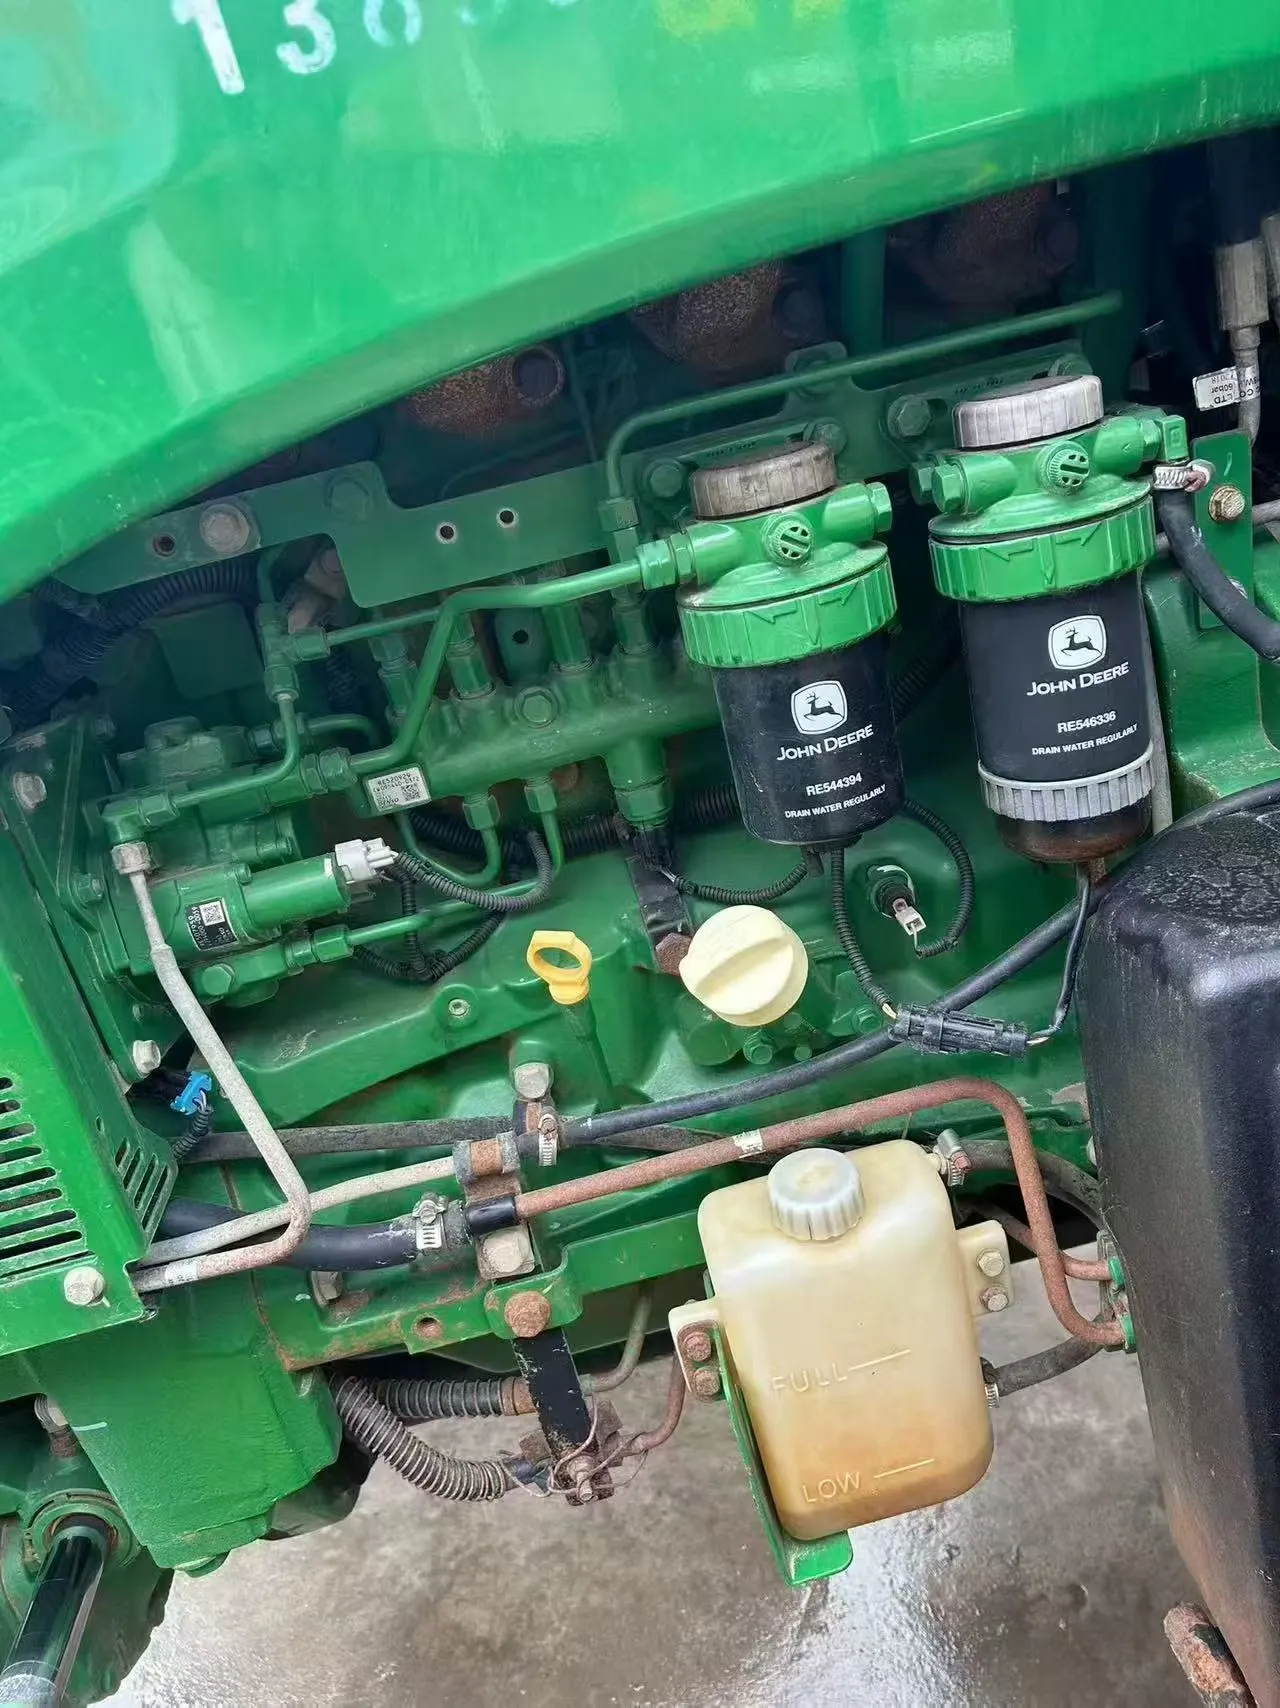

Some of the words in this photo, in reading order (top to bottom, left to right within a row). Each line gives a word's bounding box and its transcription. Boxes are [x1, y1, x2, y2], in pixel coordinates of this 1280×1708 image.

[1026, 678, 1077, 696] JOHN
[1079, 661, 1130, 688] DEERE
[1057, 710, 1117, 733] RE546336
[776, 743, 822, 761] JOHN
[823, 724, 874, 752] DEERE
[1031, 745, 1061, 755] DRAIN
[1062, 740, 1095, 753] WATER
[1095, 723, 1138, 747] REGULARLY
[806, 772, 862, 796] RE544394
[784, 808, 811, 818] DRAIN
[811, 802, 843, 815] WATER
[843, 784, 886, 808] REGULARLY
[771, 1362, 848, 1394] FULL
[802, 1471, 861, 1503] LOW
